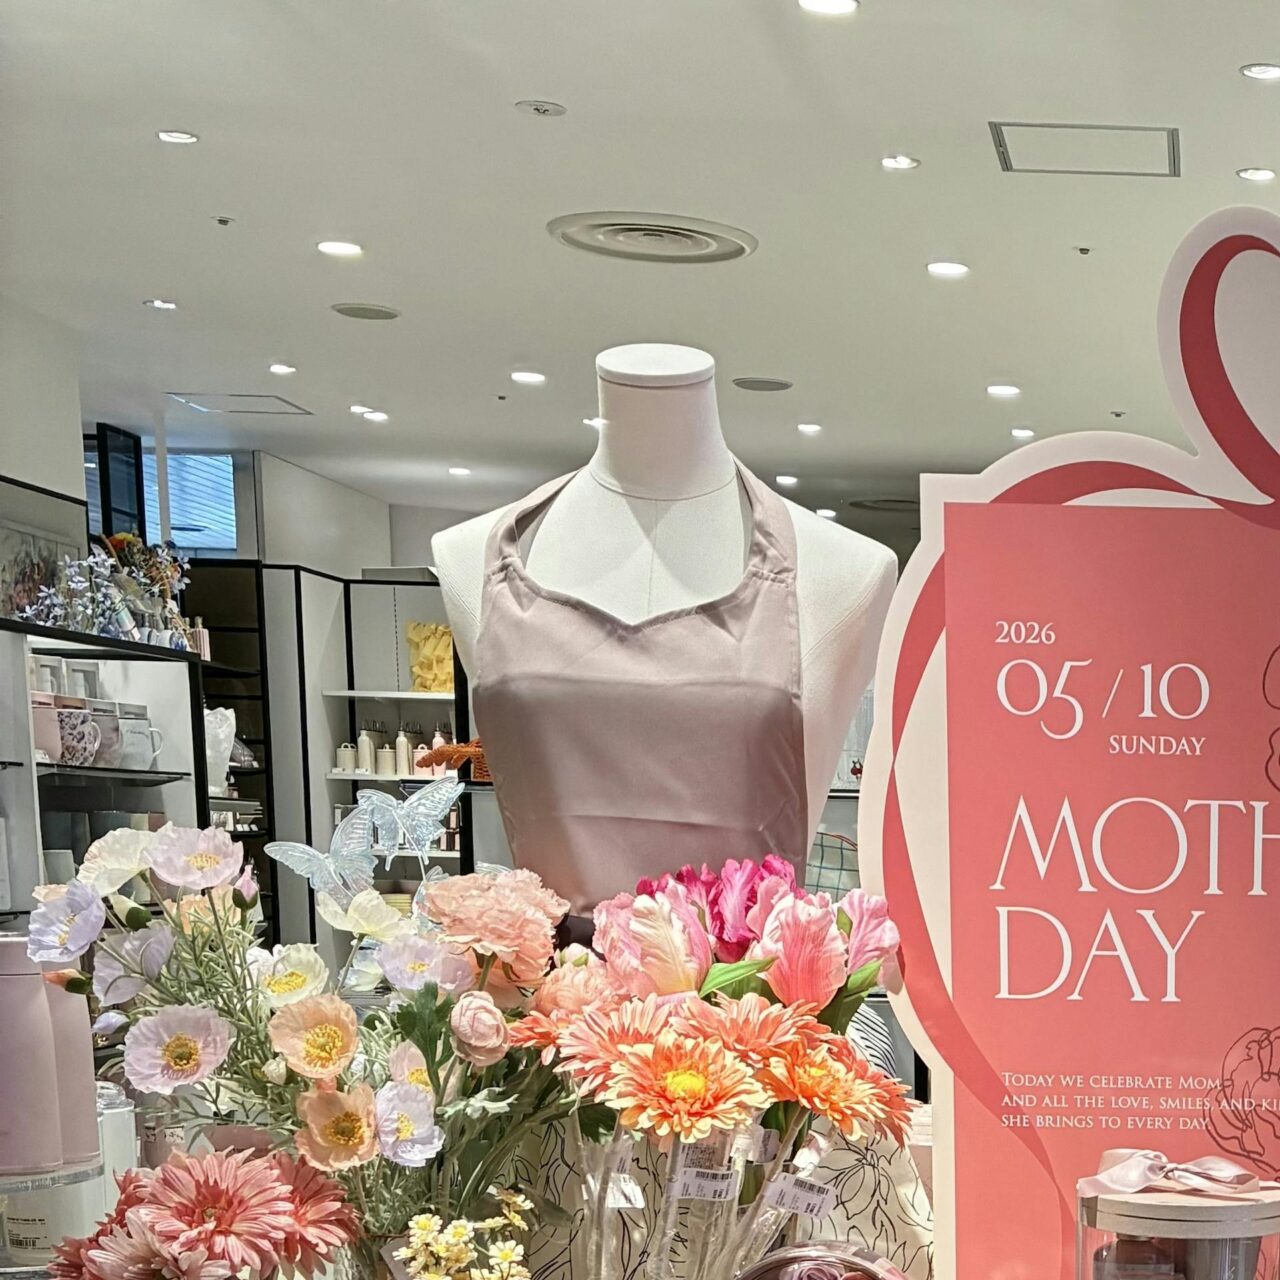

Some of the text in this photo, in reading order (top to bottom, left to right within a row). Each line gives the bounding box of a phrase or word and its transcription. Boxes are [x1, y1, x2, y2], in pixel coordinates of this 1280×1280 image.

[994, 620, 1056, 645] 2026
[1109, 734, 1206, 756] SUNDAY
[993, 906, 1206, 1003] DAY
[1001, 1072, 1055, 1087] TODAY
[1059, 1074, 1084, 1088] WE
[1089, 1075, 1173, 1089] CELEBRATE
[1001, 1094, 1037, 1108] AND
[1042, 1095, 1069, 1108] ALL
[1074, 1096, 1105, 1108] THE
[1111, 1096, 1153, 1110] LOVE,
[1159, 1097, 1215, 1111] SMILES,
[1219, 1098, 1255, 1111] AND
[1001, 1115, 1212, 1130] SHE BRINGS TO EVERY DAY.
